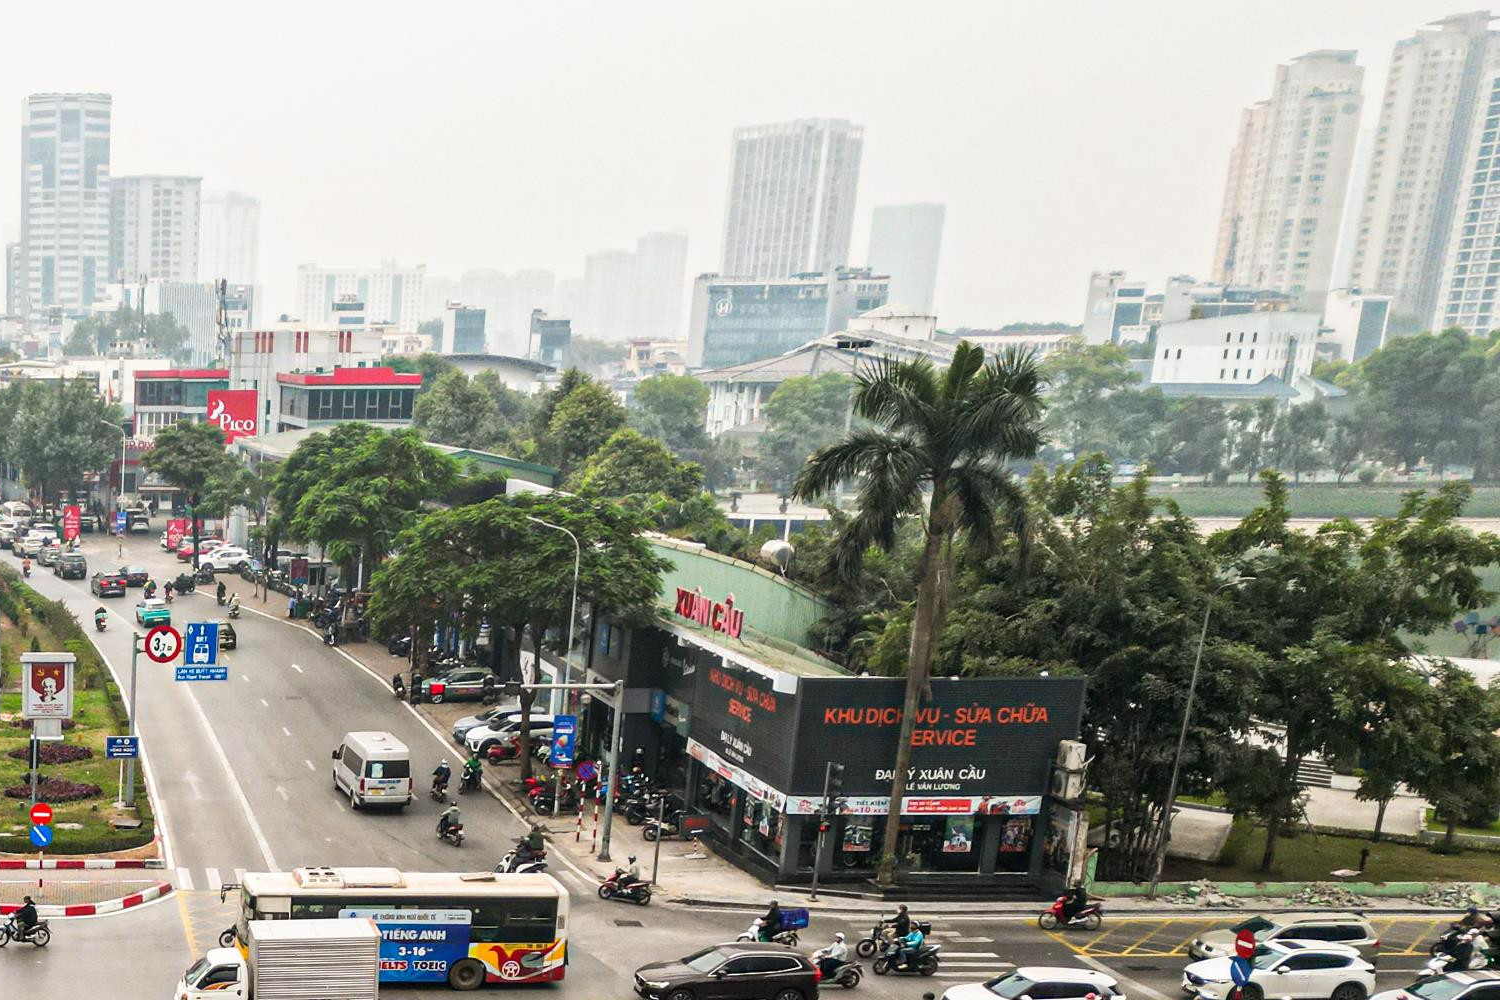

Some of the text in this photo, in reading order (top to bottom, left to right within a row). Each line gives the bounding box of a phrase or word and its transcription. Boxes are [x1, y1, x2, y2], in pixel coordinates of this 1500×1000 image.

[675, 586, 744, 638] XUÂN CẦU
[824, 707, 863, 724] KHU
[915, 707, 941, 727] VỤ
[954, 703, 992, 724] SỬA
[997, 703, 1048, 724] CHỮA
[910, 729, 977, 746] ERVICE
[918, 769, 954, 780] XUÂN
[958, 764, 986, 780] CẦU
[382, 928, 447, 940] TIẾNG ANH
[398, 946, 426, 956] 3-16
[413, 961, 447, 970] TOEIC
